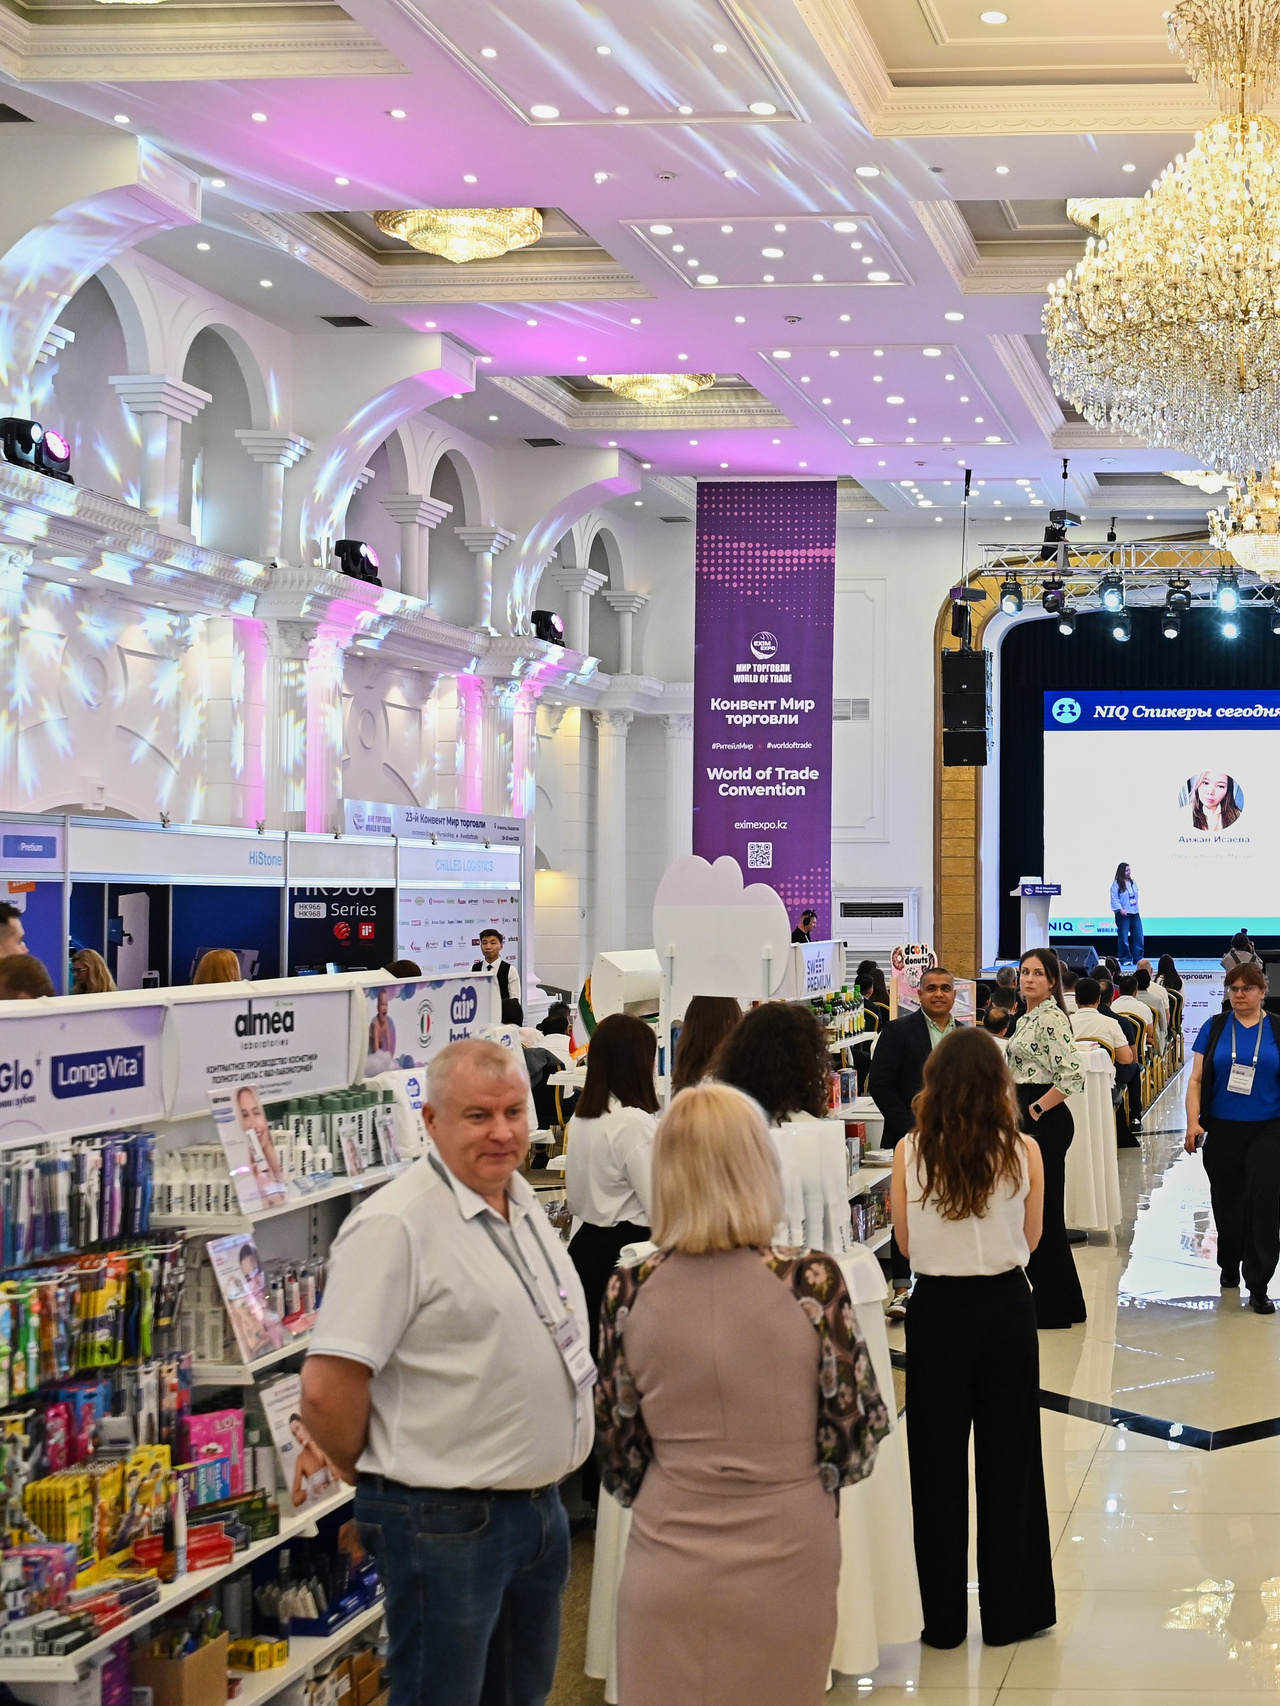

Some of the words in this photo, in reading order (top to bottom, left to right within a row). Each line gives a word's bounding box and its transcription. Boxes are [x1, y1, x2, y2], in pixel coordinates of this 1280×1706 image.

[736, 664, 751, 673] МИР
[752, 664, 790, 673] ТОРГОВЛИ
[733, 674, 758, 683] WORLD
[760, 674, 769, 683] OF
[770, 674, 792, 683] TRADE
[710, 698, 777, 710] Конвент
[780, 697, 815, 713] Мир
[1093, 705, 1130, 720] NIQ
[1132, 705, 1212, 720] Спикеры
[725, 714, 799, 728] торговли
[712, 742, 754, 751] #РитейлМир
[706, 766, 752, 780] World
[755, 766, 772, 780] of
[775, 766, 820, 780] Trade
[718, 782, 806, 796] Convention
[405, 812, 418, 822] 23-й
[420, 814, 446, 826] Конвент
[446, 816, 459, 829] Мир
[460, 818, 486, 830] торговли
[734, 820, 788, 830] eximexpo.kz
[1214, 835, 1250, 843] Исаева
[249, 851, 282, 866] HiStone
[436, 859, 462, 871] CHILLED
[463, 860, 493, 872] LOGISTICS
[331, 903, 376, 916] Series
[1049, 922, 1073, 931] NIQ
[905, 956, 928, 965] donuts
[807, 974, 831, 992] PREMIUM
[453, 993, 474, 1020] air
[235, 1000, 294, 1037] almea
